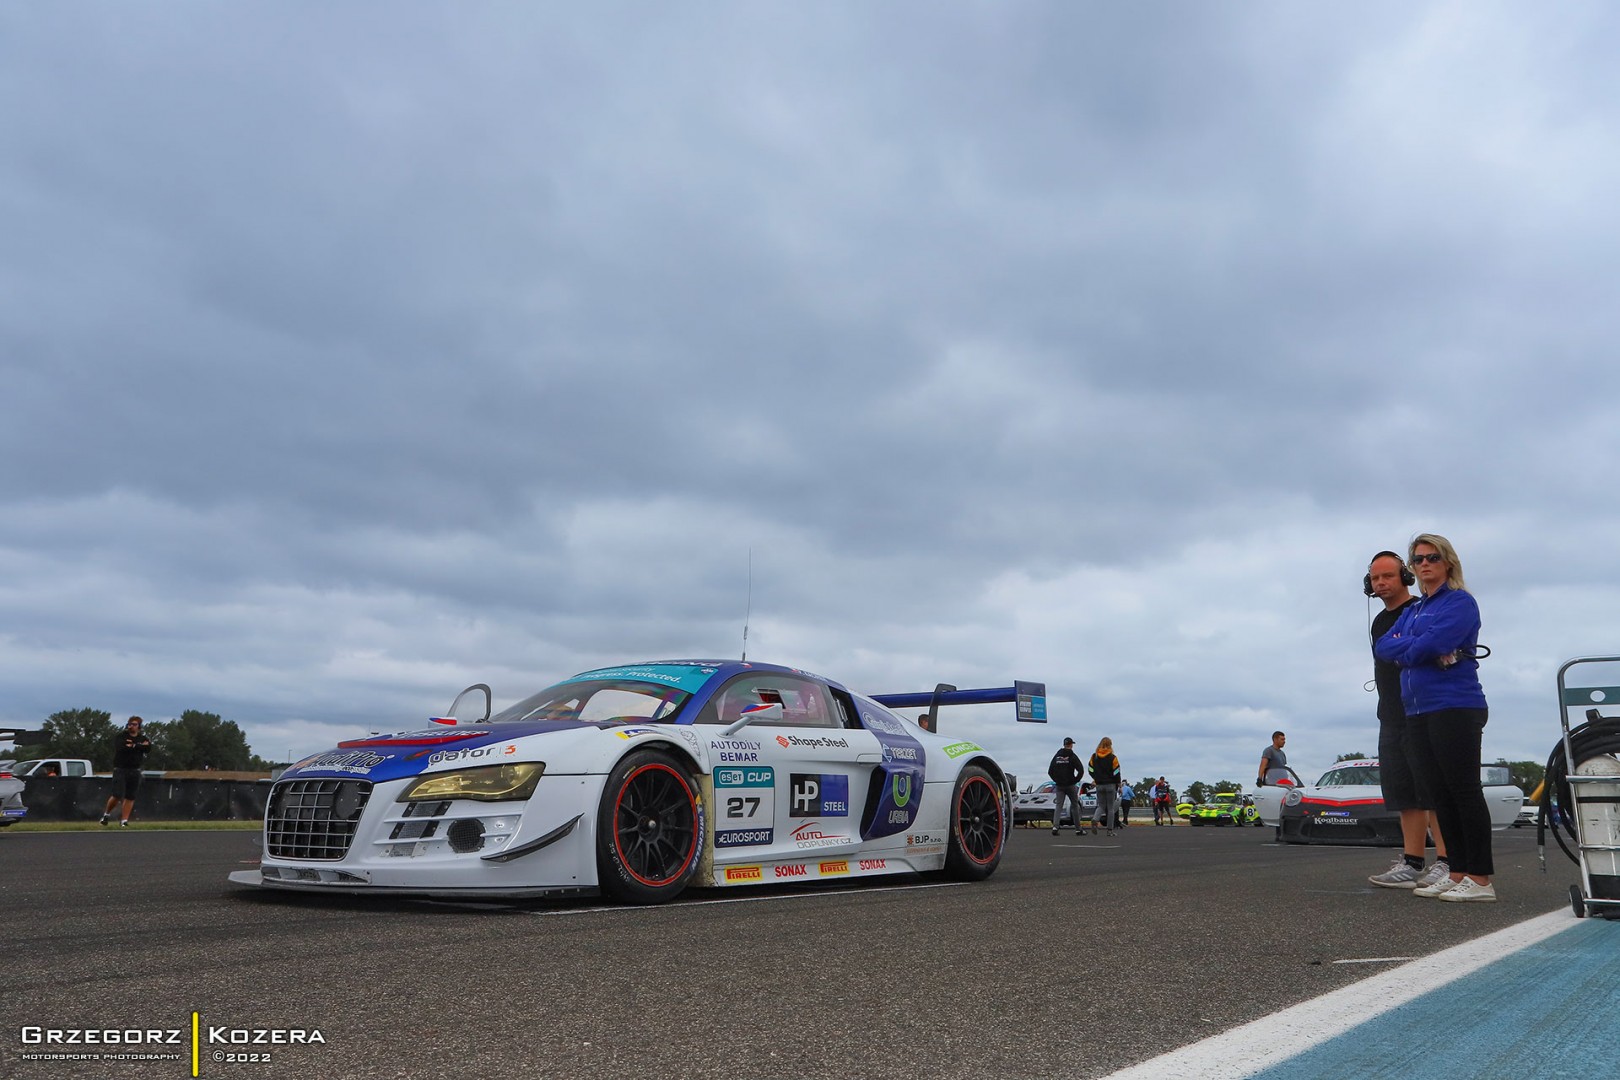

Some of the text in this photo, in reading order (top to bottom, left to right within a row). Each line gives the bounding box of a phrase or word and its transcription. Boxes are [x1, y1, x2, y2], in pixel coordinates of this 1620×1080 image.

[625, 671, 681, 684] Protected.
[504, 745, 516, 755] 3
[710, 740, 762, 751] AUTODÍLY
[719, 752, 759, 762] BEMAR
[720, 772, 772, 783] eset CUP
[793, 780, 846, 812] HP STEEL
[727, 797, 761, 818] 27
[1247, 807, 1255, 817] 8
[1314, 817, 1359, 825] Koglbauer
[720, 831, 771, 844] EUROSPORT
[795, 831, 823, 841] AUTO
[915, 835, 930, 844] BJP
[691, 815, 705, 871] MICHELIN
[796, 837, 854, 849] DOPLNKY.CZ
[820, 861, 848, 873] PIRELLI
[859, 858, 887, 871] SONAX
[726, 867, 761, 880] PIRELLI
[774, 864, 807, 878] SONAX
